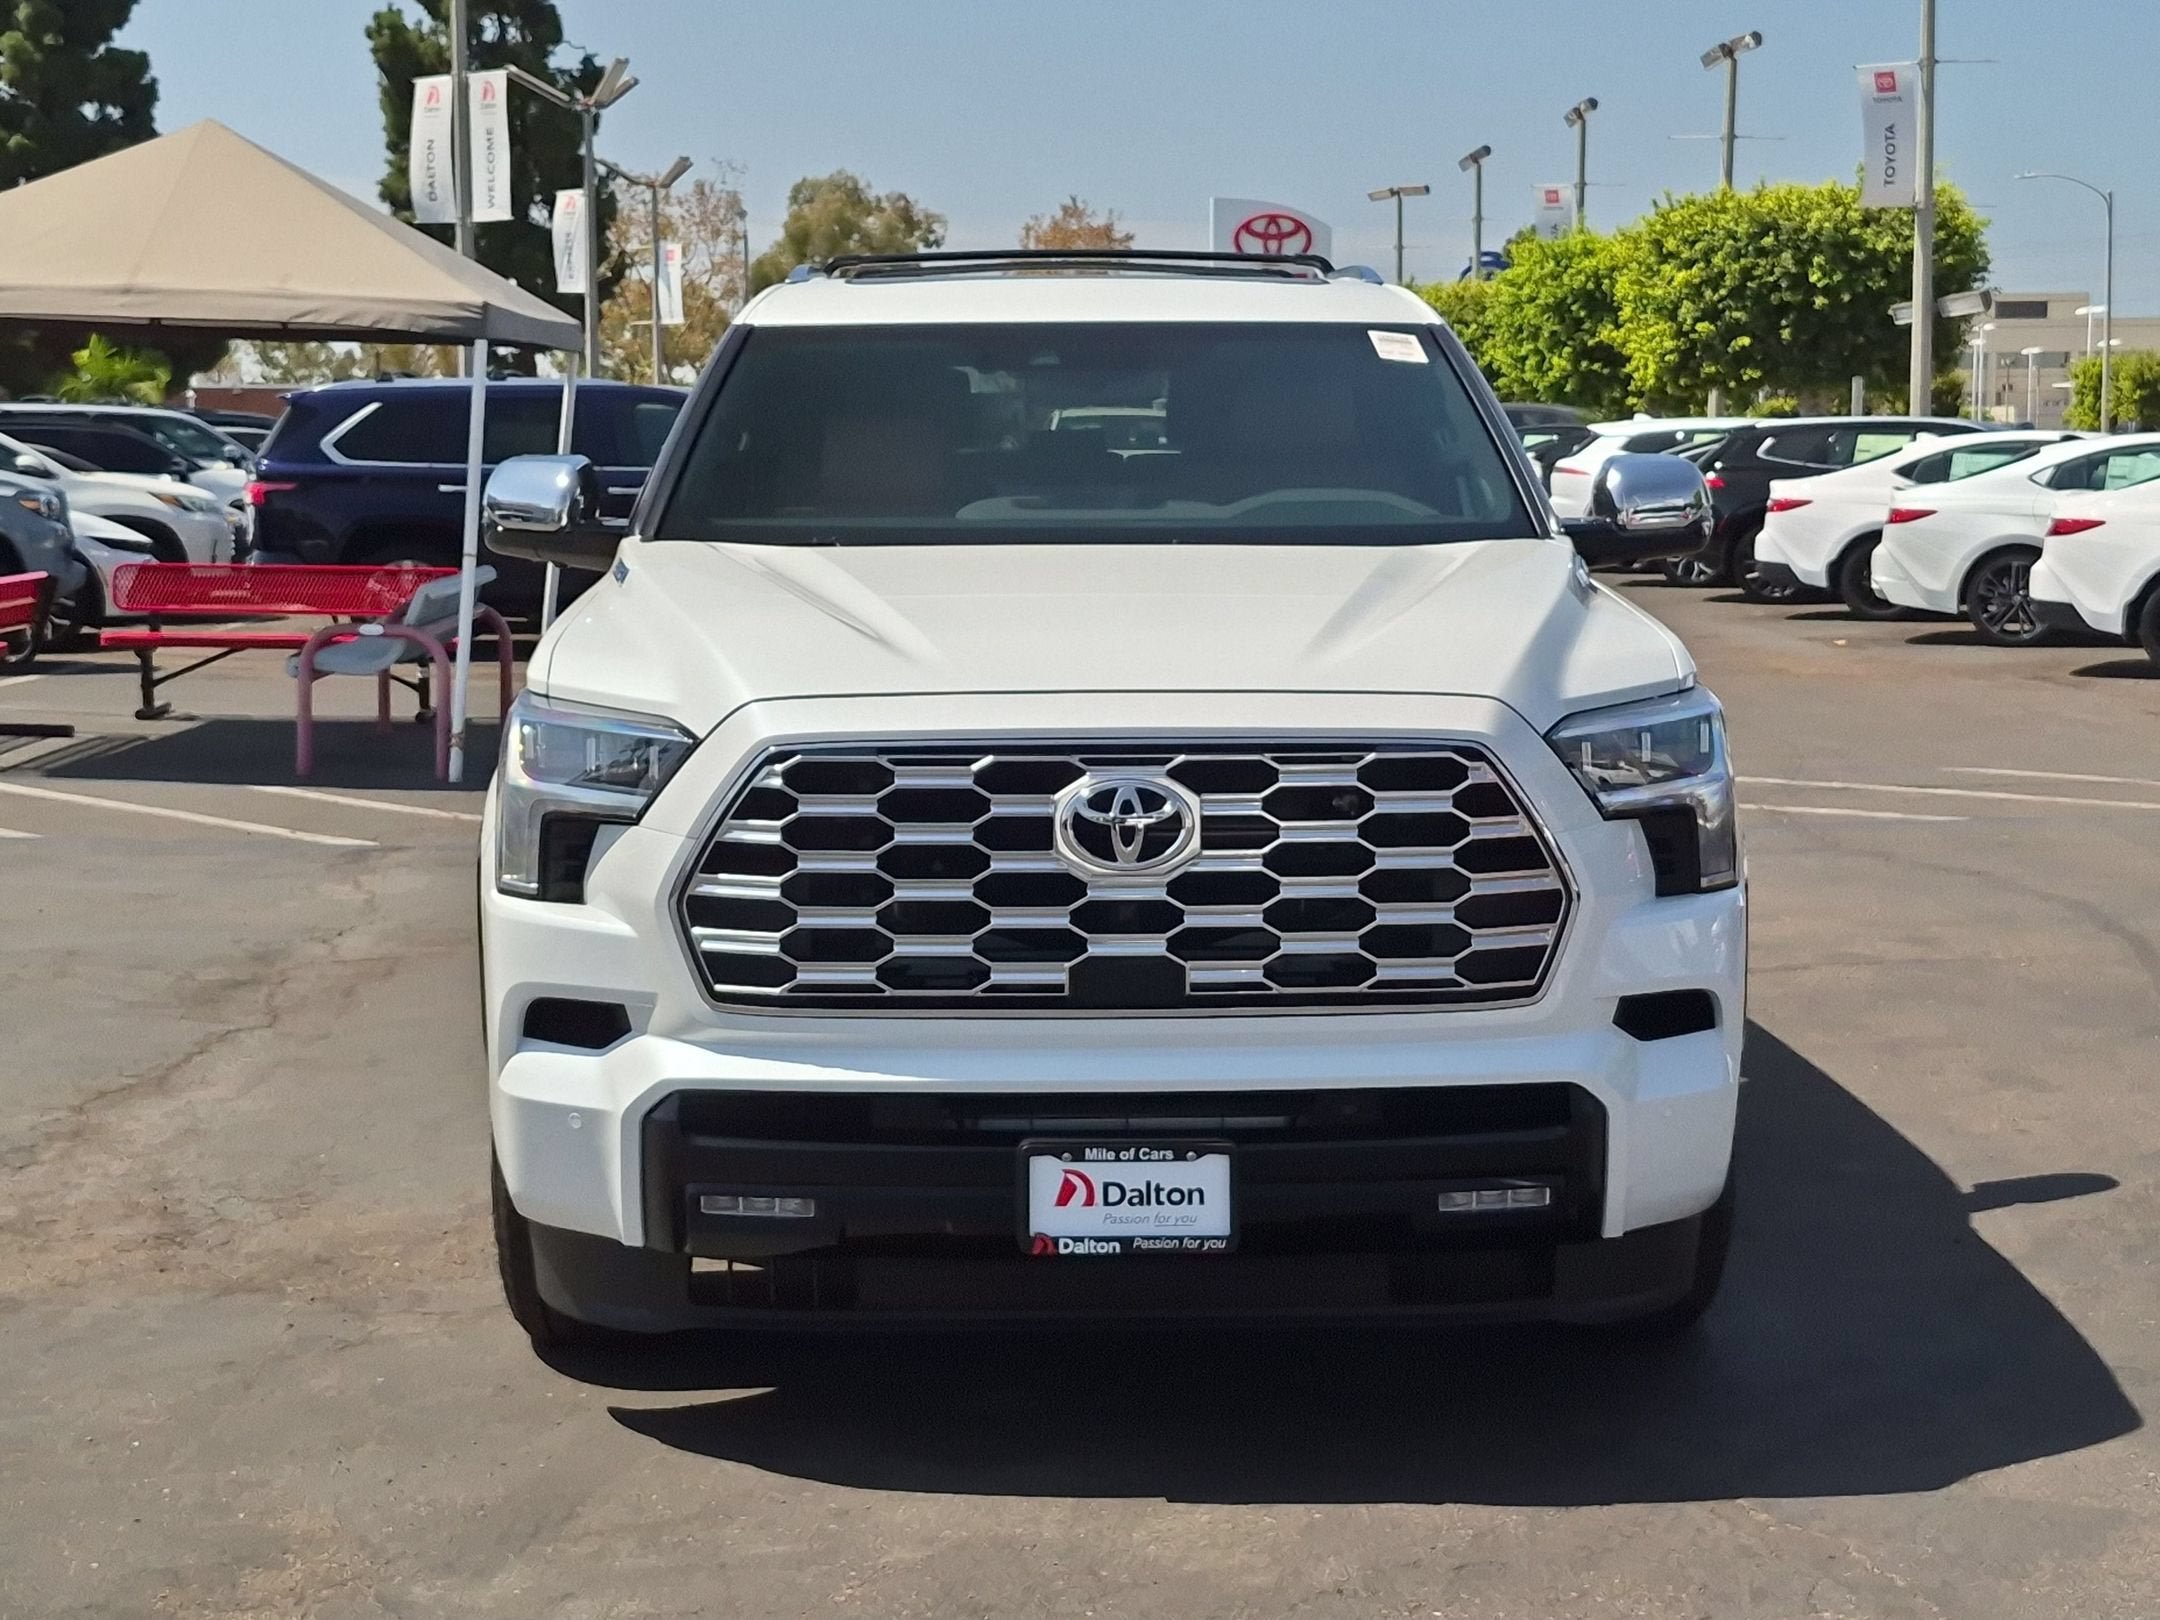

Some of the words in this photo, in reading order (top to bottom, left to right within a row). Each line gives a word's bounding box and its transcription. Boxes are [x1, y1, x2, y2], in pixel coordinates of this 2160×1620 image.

[1884, 123, 1896, 188] TOYOTA
[486, 127, 496, 209] WELCOME
[1084, 1147, 1116, 1160] Mile
[1119, 1147, 1136, 1160] of
[1139, 1147, 1174, 1160] Cars
[1102, 1180, 1205, 1207] Dalton
[1103, 1212, 1150, 1224] Passion
[1153, 1211, 1172, 1224] for
[1173, 1214, 1198, 1225] you
[1058, 1238, 1121, 1254] Dalton
[1132, 1237, 1179, 1249] Passion
[1182, 1238, 1200, 1249] for
[1202, 1239, 1227, 1251] you
